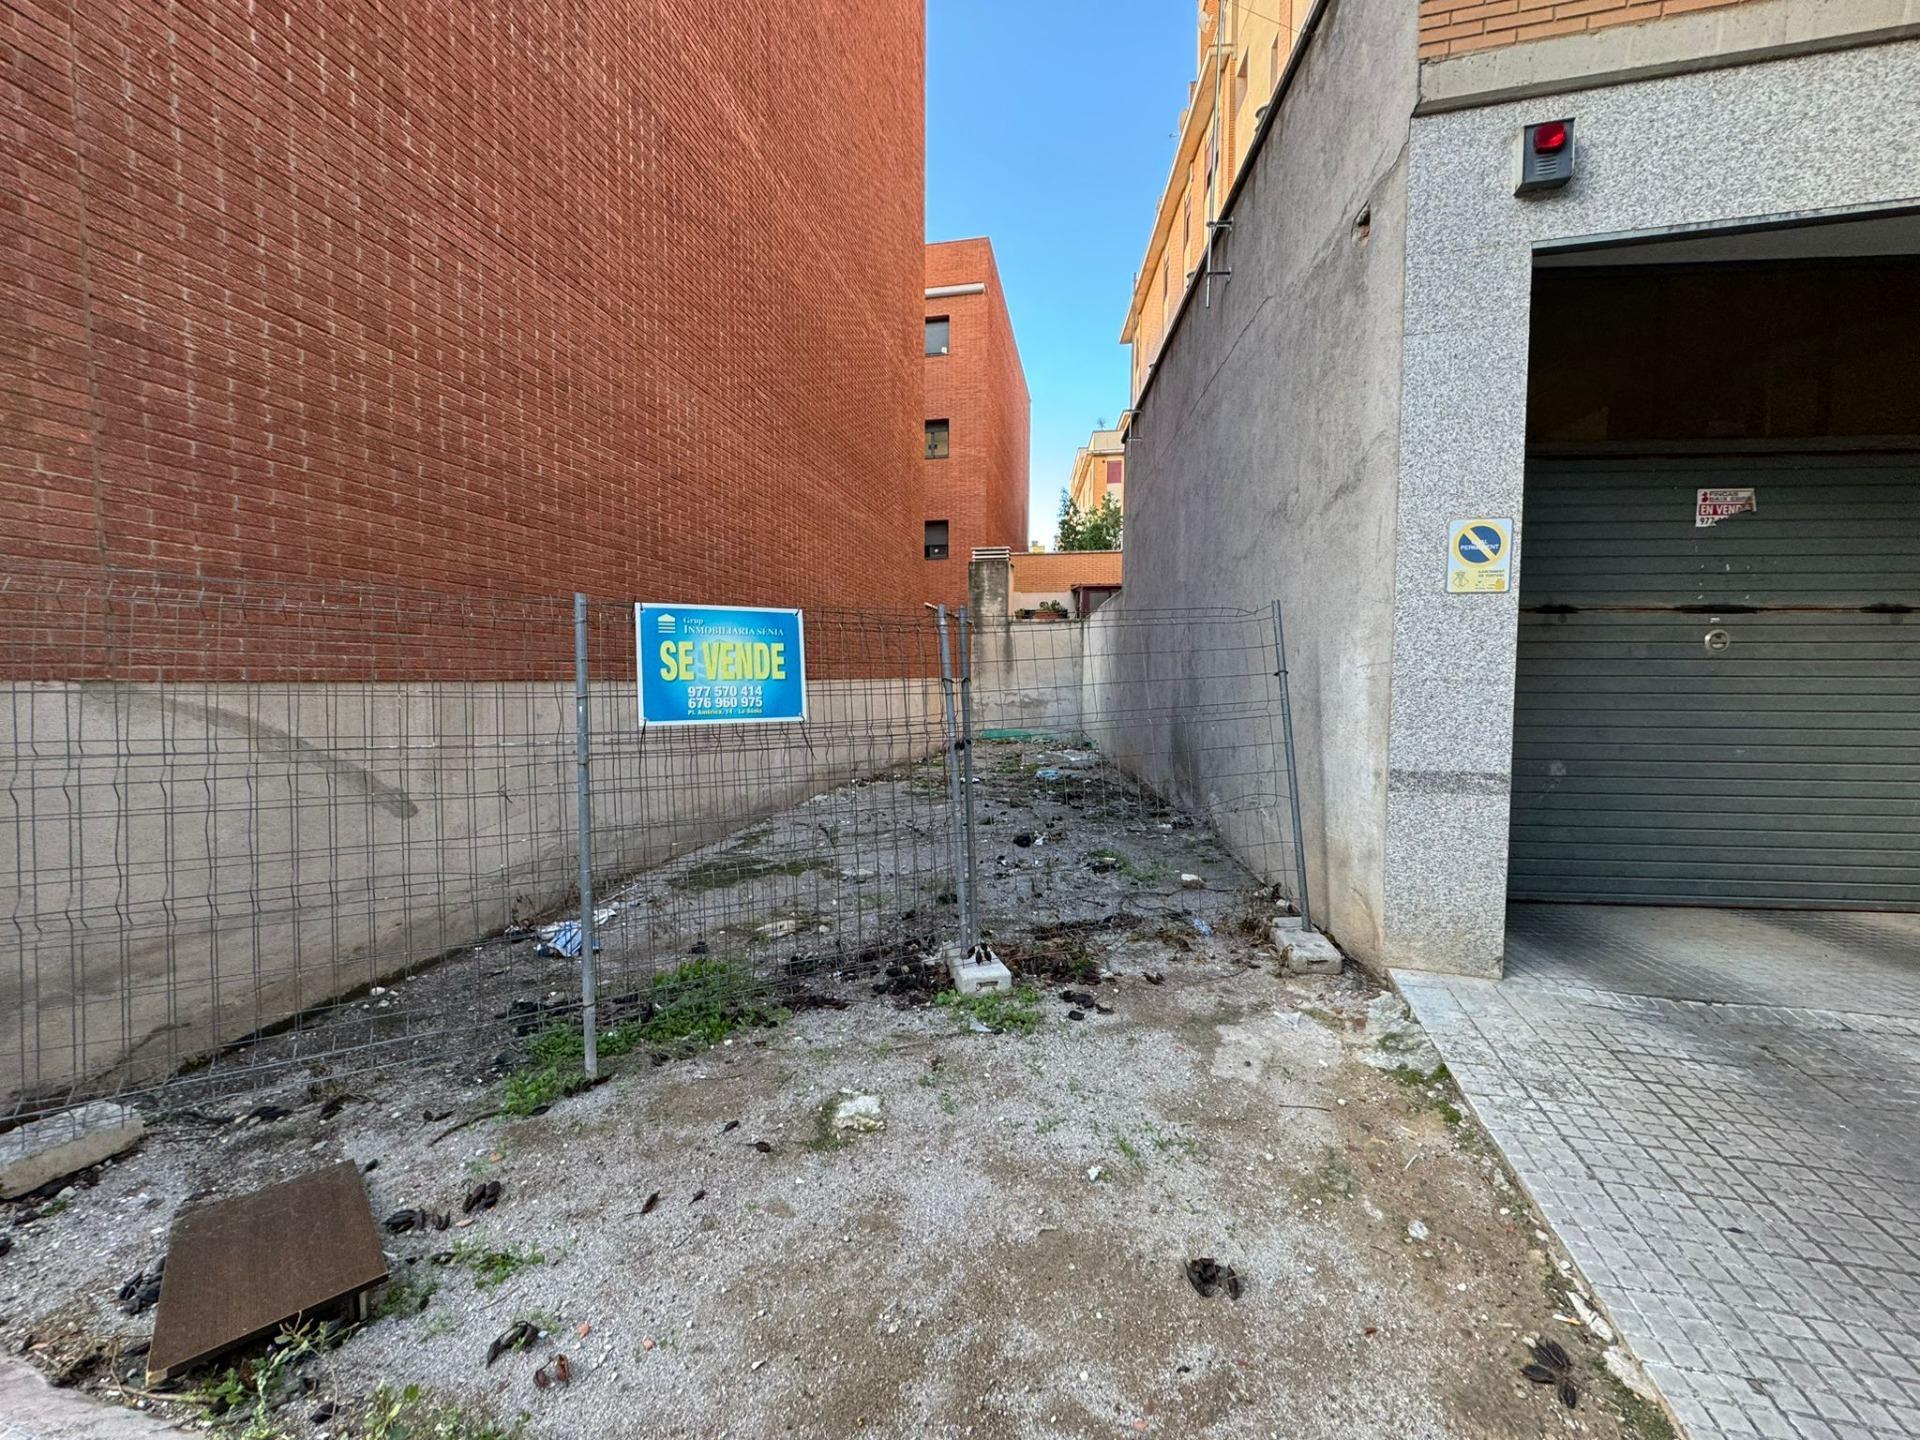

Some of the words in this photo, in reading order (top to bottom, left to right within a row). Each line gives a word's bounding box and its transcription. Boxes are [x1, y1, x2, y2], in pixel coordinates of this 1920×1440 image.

[1700, 504, 1714, 515] EN
[683, 617, 704, 626] Grup
[660, 640, 696, 682] SE
[702, 640, 787, 682] VENDE
[688, 686, 711, 698] 977
[714, 686, 738, 698] 570
[741, 685, 763, 697] 414
[688, 697, 711, 709] 676
[715, 697, 738, 708] 960
[741, 697, 763, 708] 975
